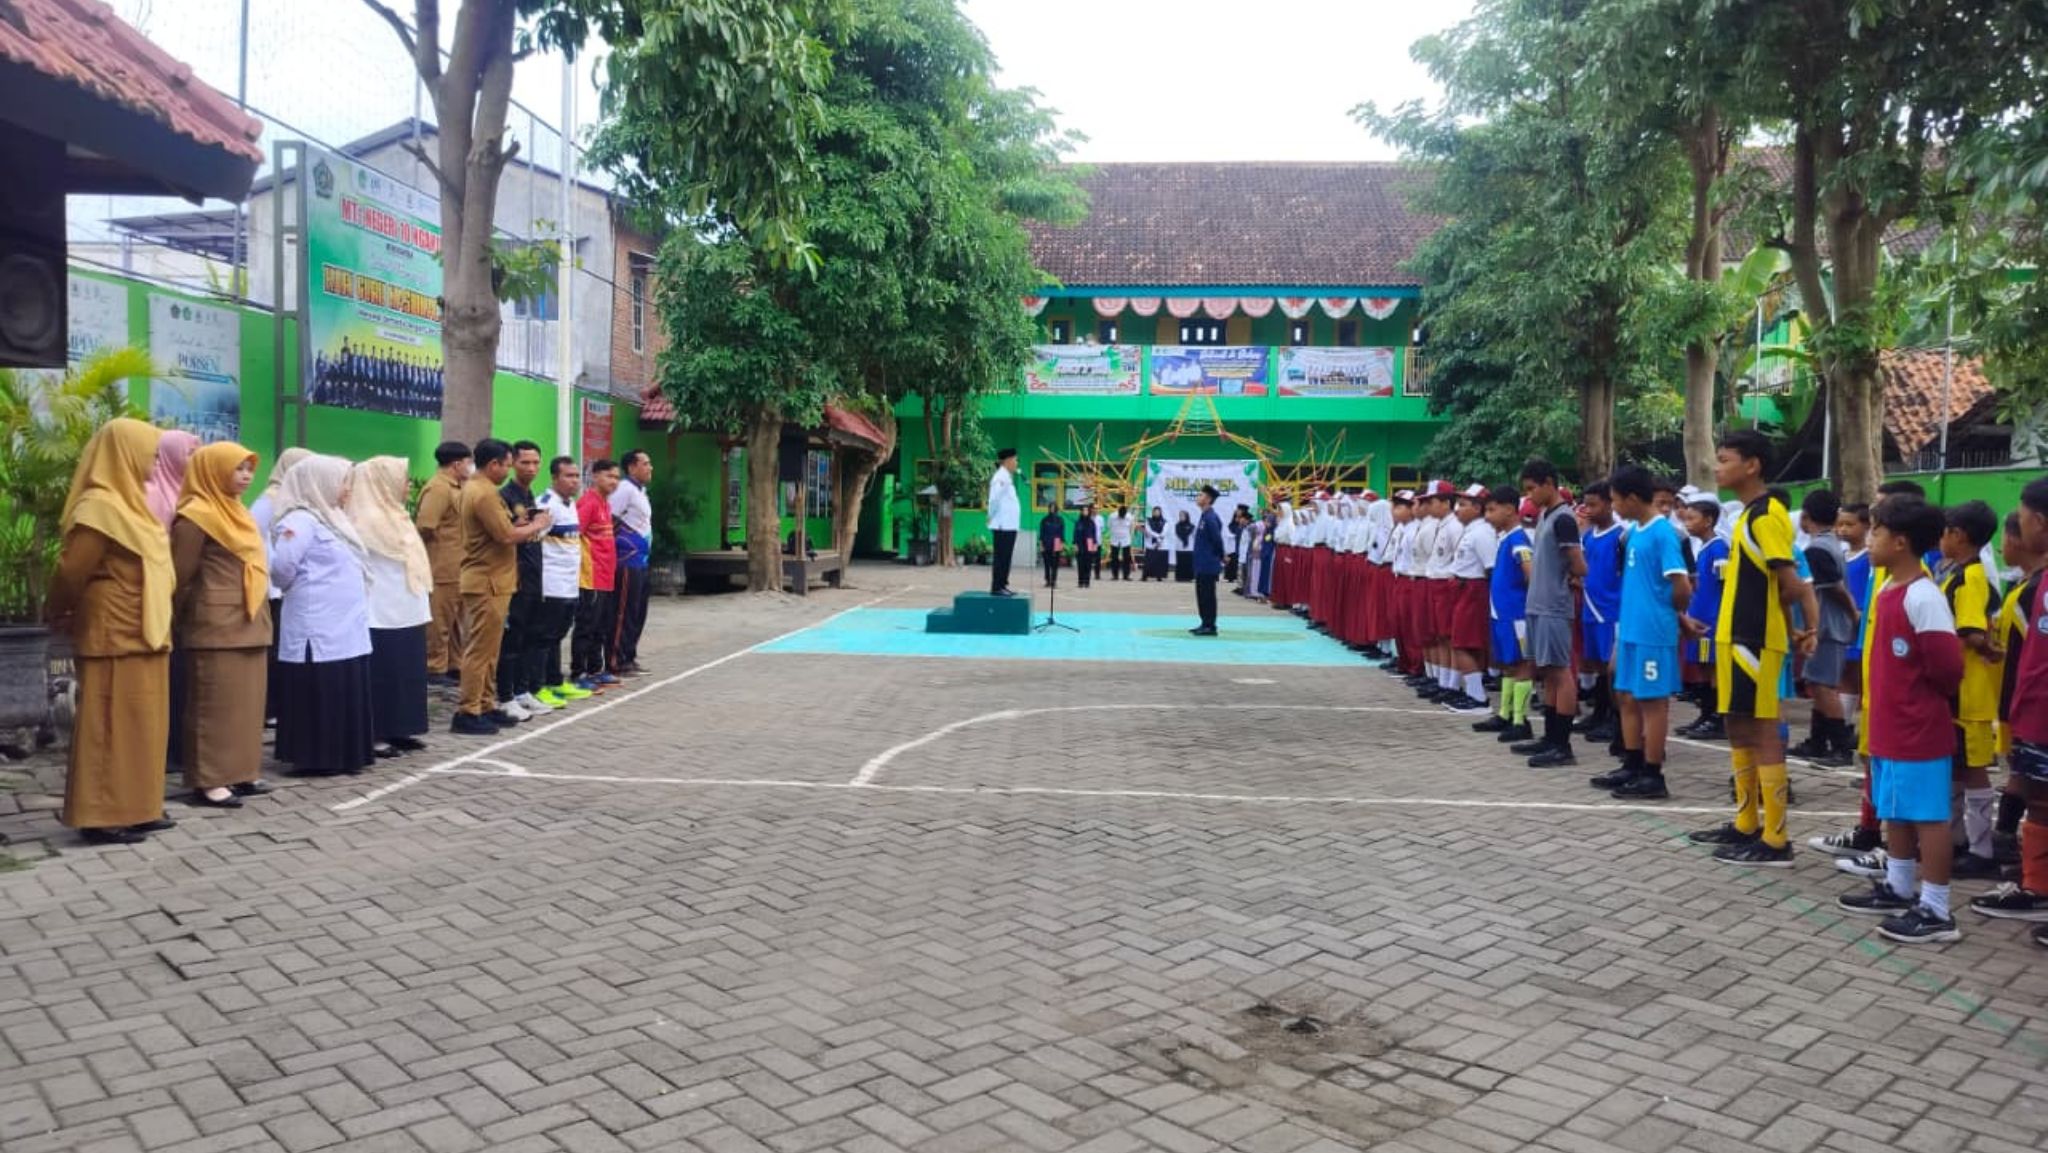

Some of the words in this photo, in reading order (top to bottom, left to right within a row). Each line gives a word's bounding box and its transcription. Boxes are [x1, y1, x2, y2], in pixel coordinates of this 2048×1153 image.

[363, 205, 398, 239] NEGERI
[401, 220, 411, 244] 10
[412, 225, 441, 253] NGAW
[356, 273, 385, 307] GURU
[1644, 660, 1659, 681] 5
